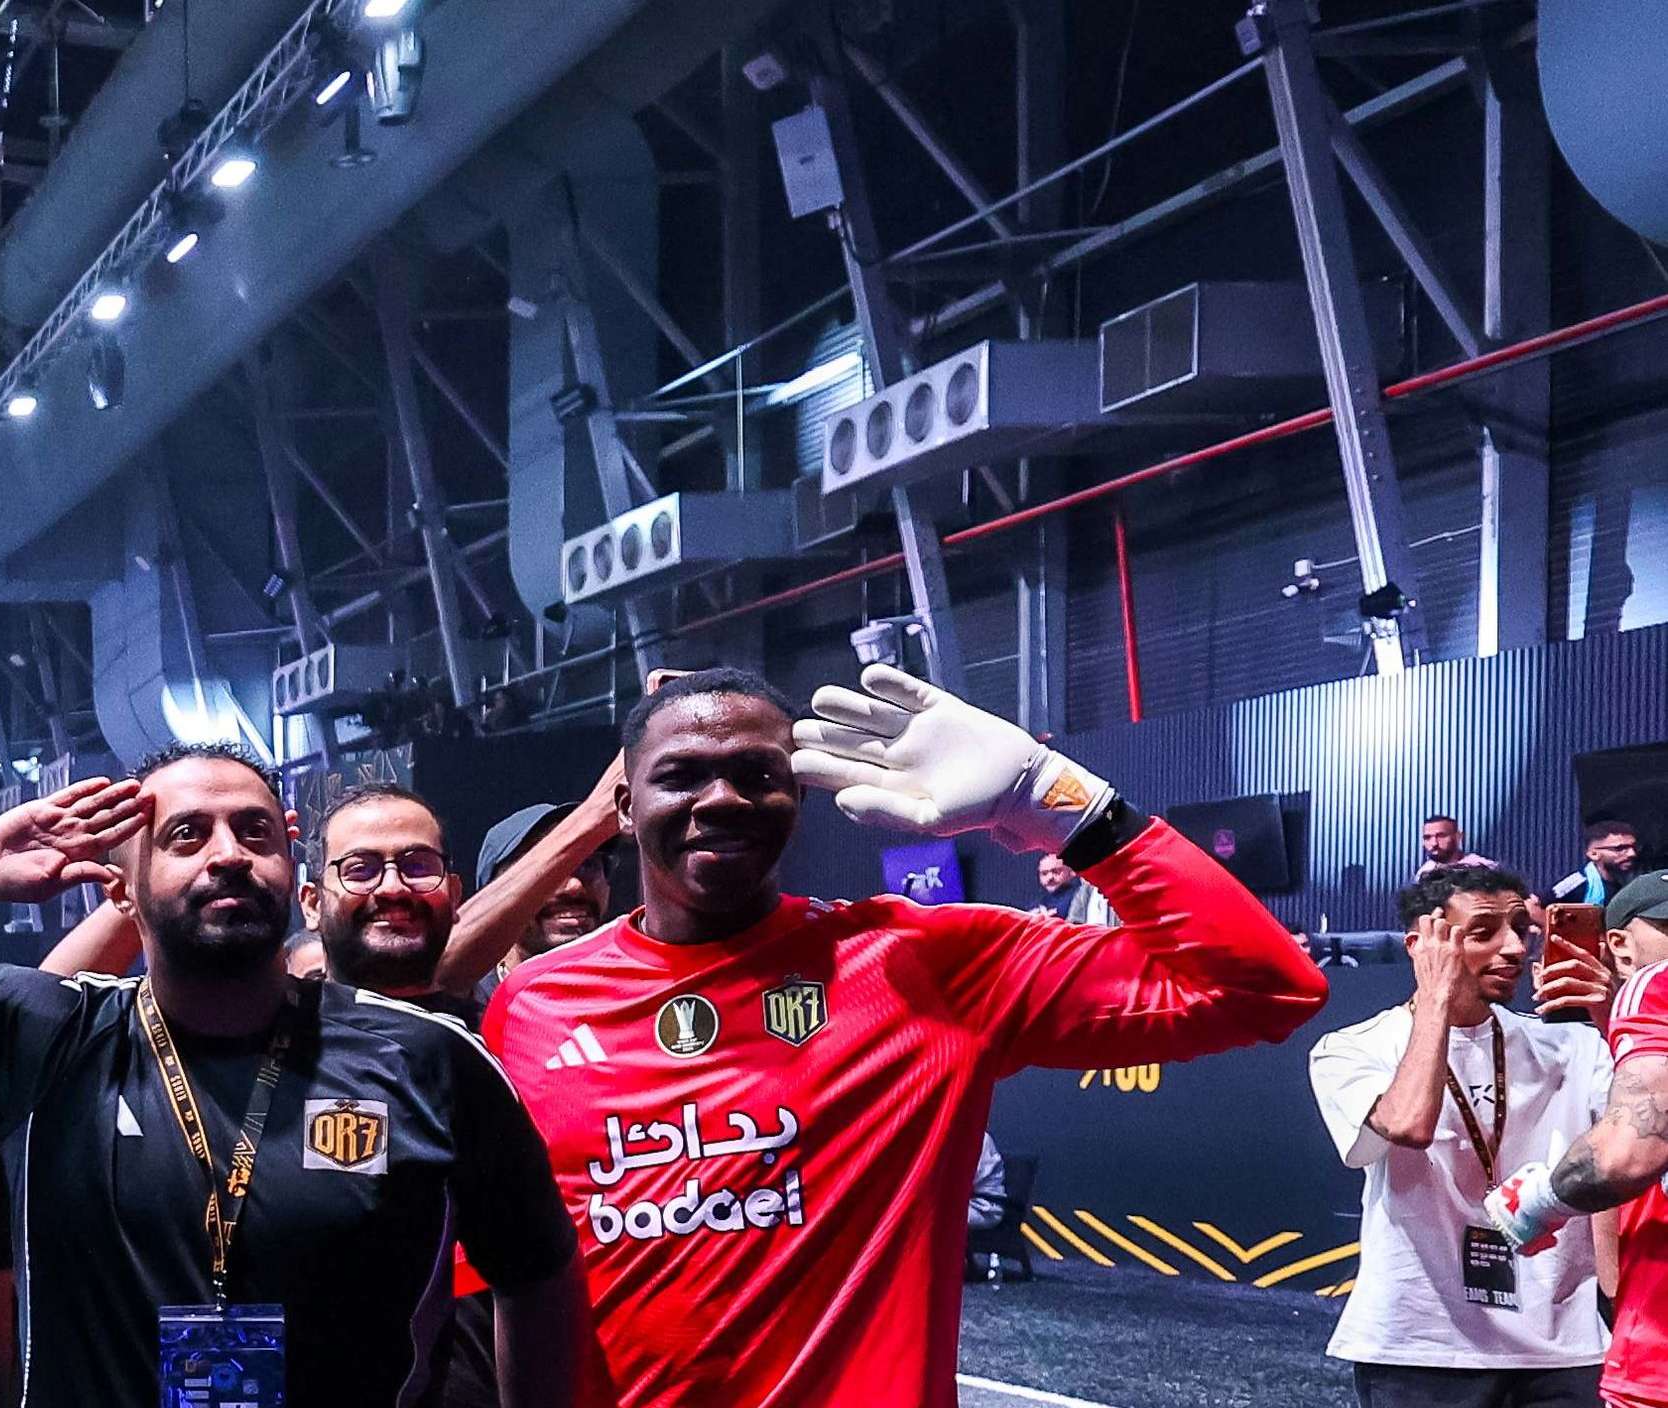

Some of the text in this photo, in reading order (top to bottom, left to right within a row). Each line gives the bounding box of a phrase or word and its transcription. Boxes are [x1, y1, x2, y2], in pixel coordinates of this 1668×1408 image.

[768, 983, 822, 1039] DR7
[314, 1111, 381, 1166] DR7
[588, 1103, 799, 1186] بدائل
[587, 1171, 805, 1246] badael
